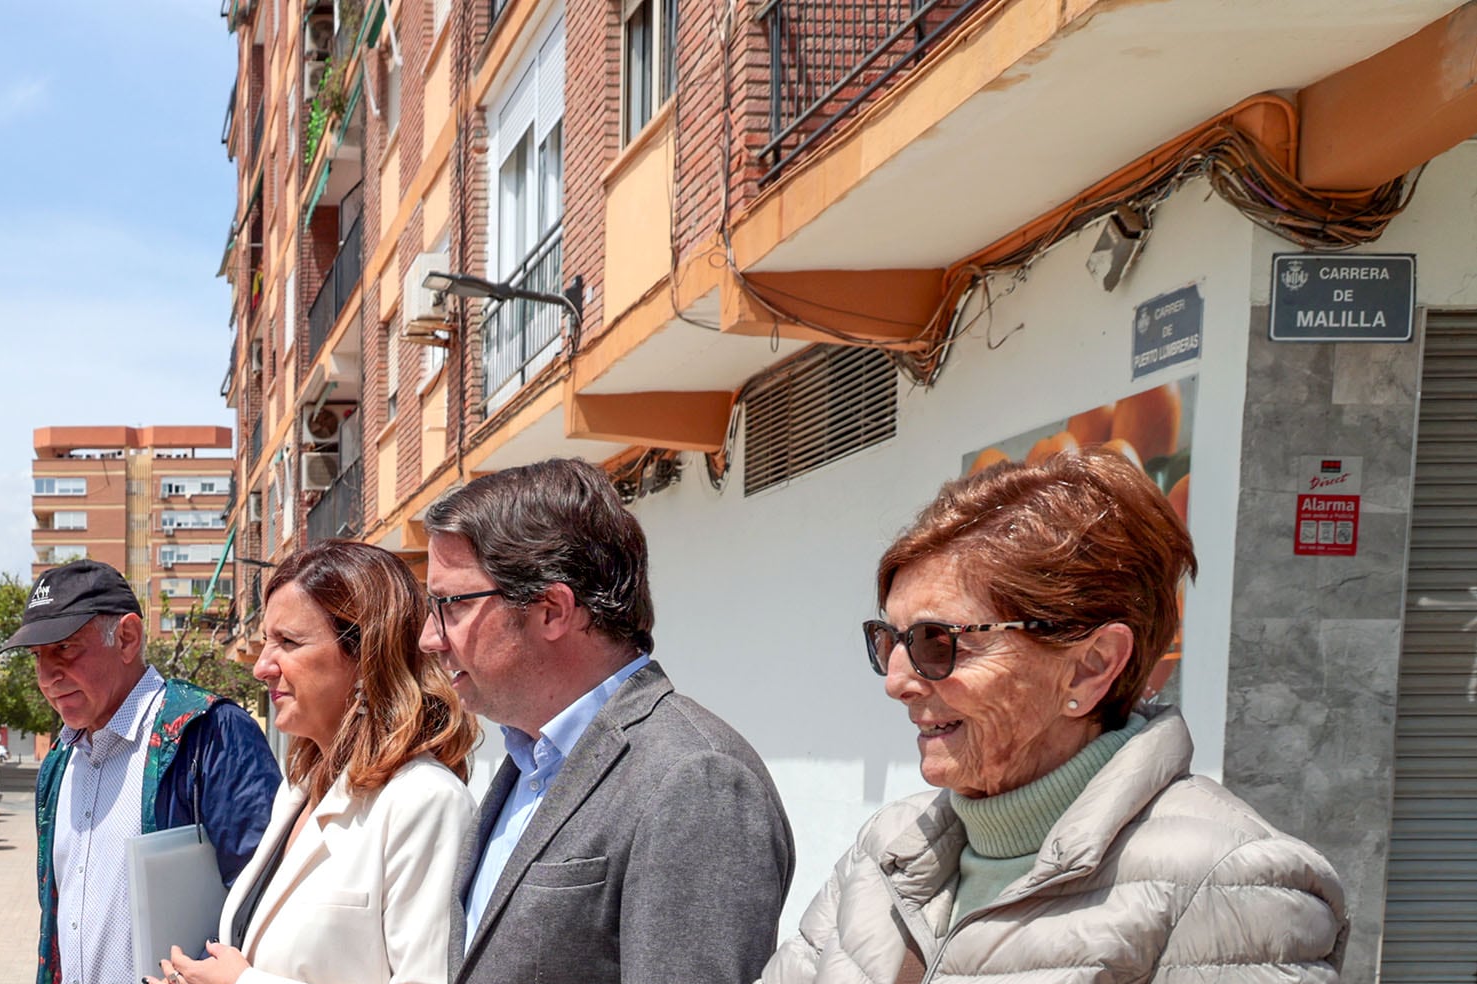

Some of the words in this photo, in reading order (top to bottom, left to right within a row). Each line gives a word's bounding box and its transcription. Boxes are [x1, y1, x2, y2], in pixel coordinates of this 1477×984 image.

[1319, 267, 1390, 280] CARRERA
[1333, 289, 1354, 302] DE
[1296, 310, 1386, 328] MALILLA
[1162, 324, 1173, 338] DE
[1135, 348, 1158, 368] PUERTO
[1302, 497, 1355, 512] Alarma
